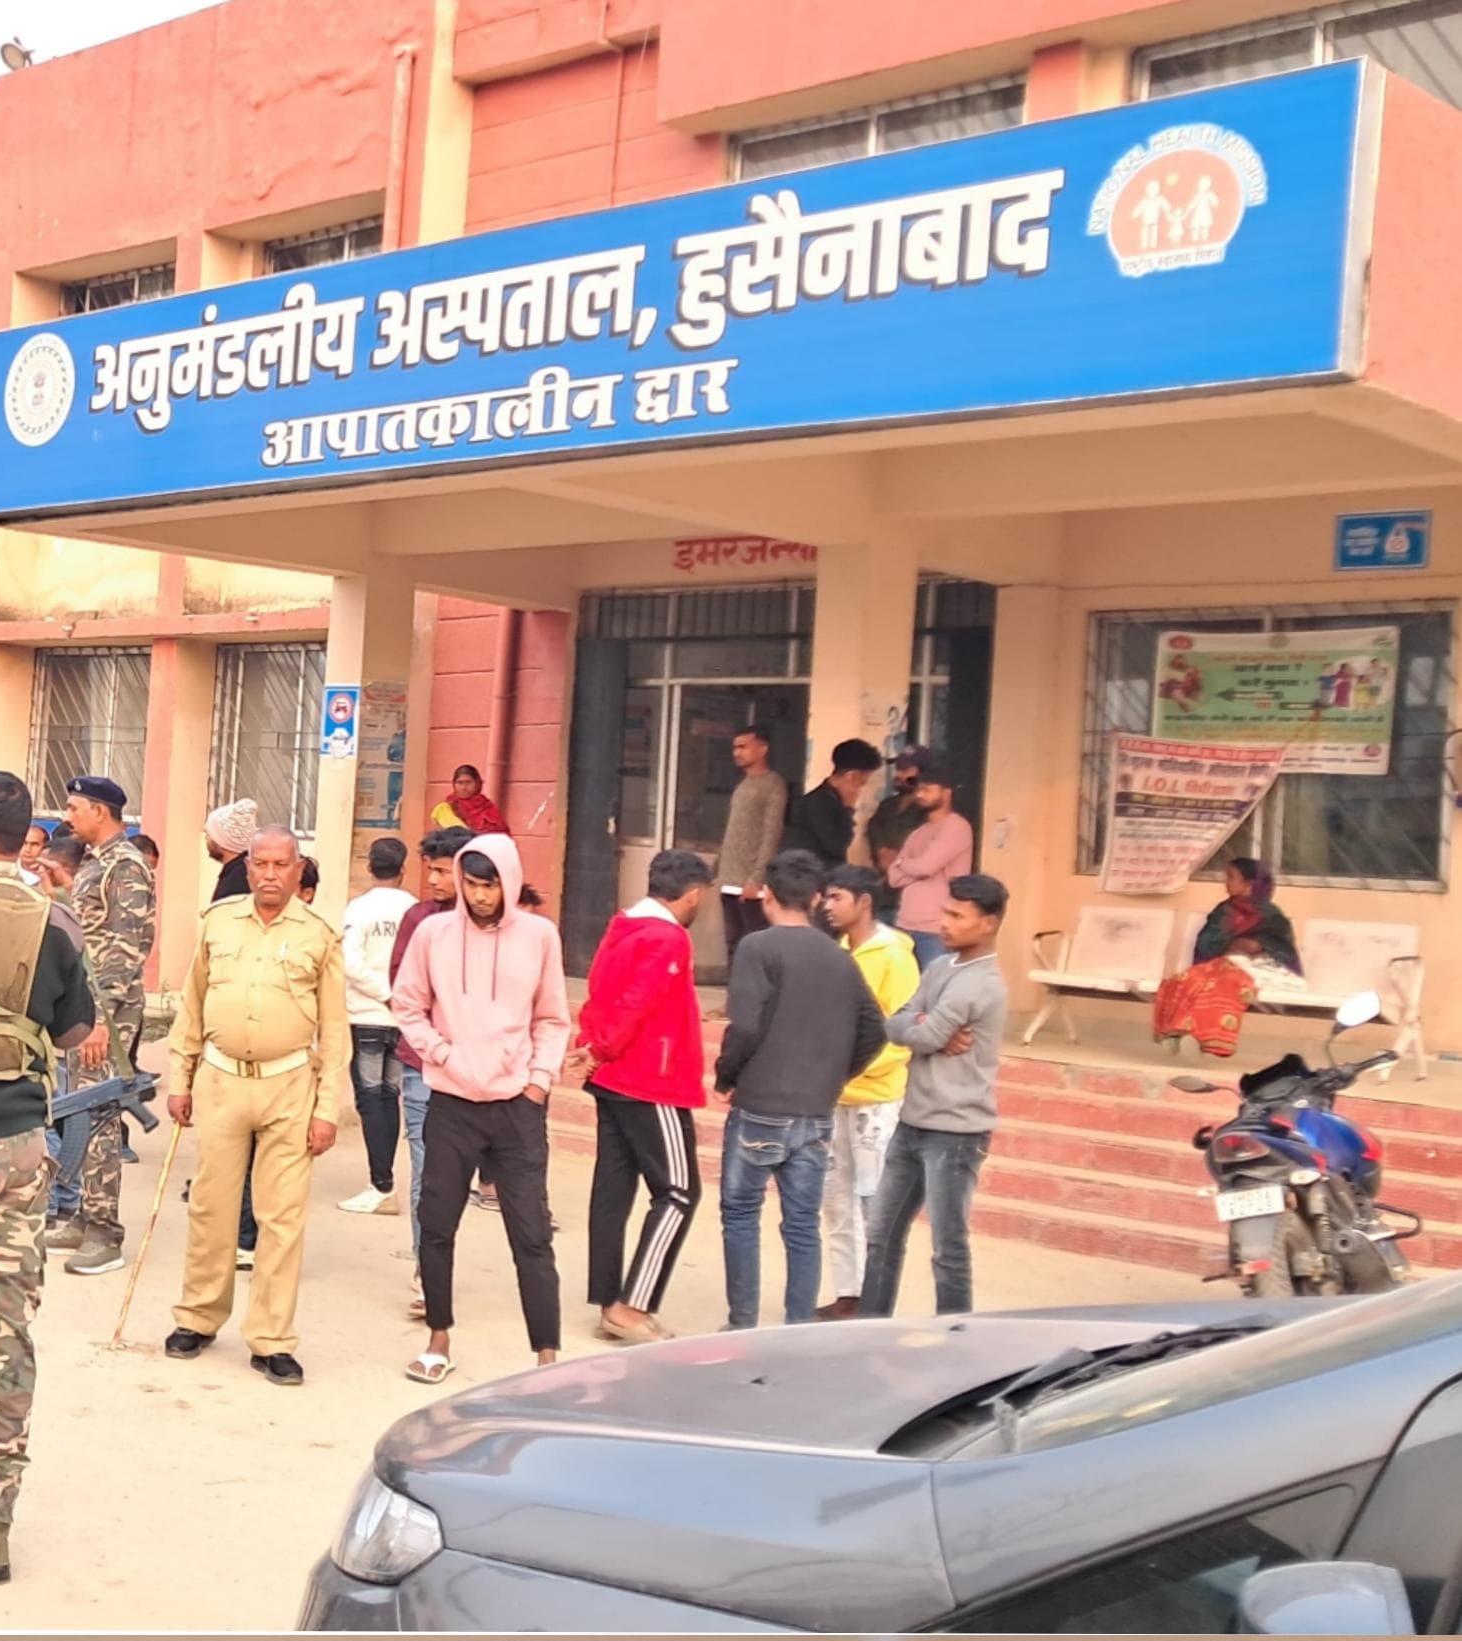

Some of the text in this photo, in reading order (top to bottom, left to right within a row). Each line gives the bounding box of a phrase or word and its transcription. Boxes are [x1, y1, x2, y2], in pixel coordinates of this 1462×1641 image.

[90, 169, 1065, 431] अनुमंडलीय अस्पताल, हुसैनाबाद
[261, 358, 739, 467] आपातकालीन द्वार
